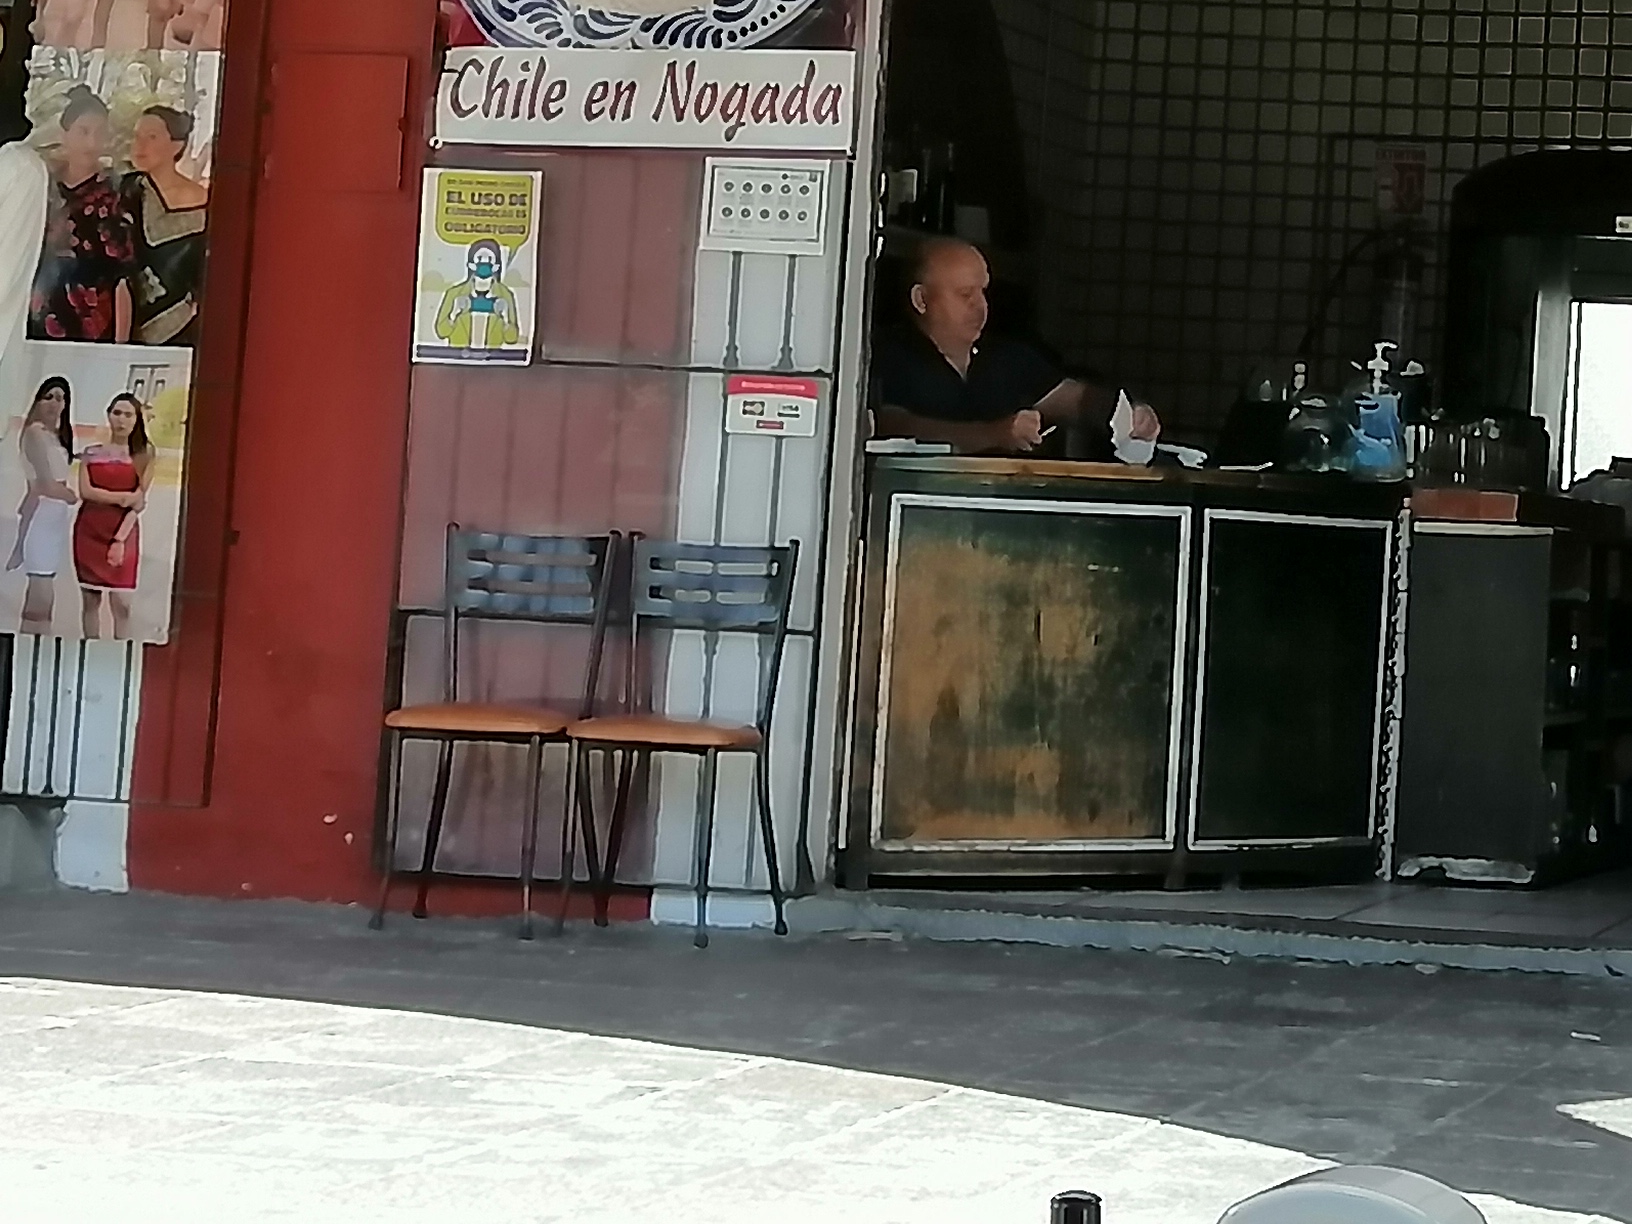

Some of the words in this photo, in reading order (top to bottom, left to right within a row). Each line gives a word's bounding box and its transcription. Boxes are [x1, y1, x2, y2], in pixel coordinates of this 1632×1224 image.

[450, 55, 567, 121] Chile
[584, 78, 637, 121] en
[652, 60, 842, 141] Nogada
[446, 190, 466, 204] EL
[470, 192, 505, 206] USO
[508, 193, 528, 206] DE
